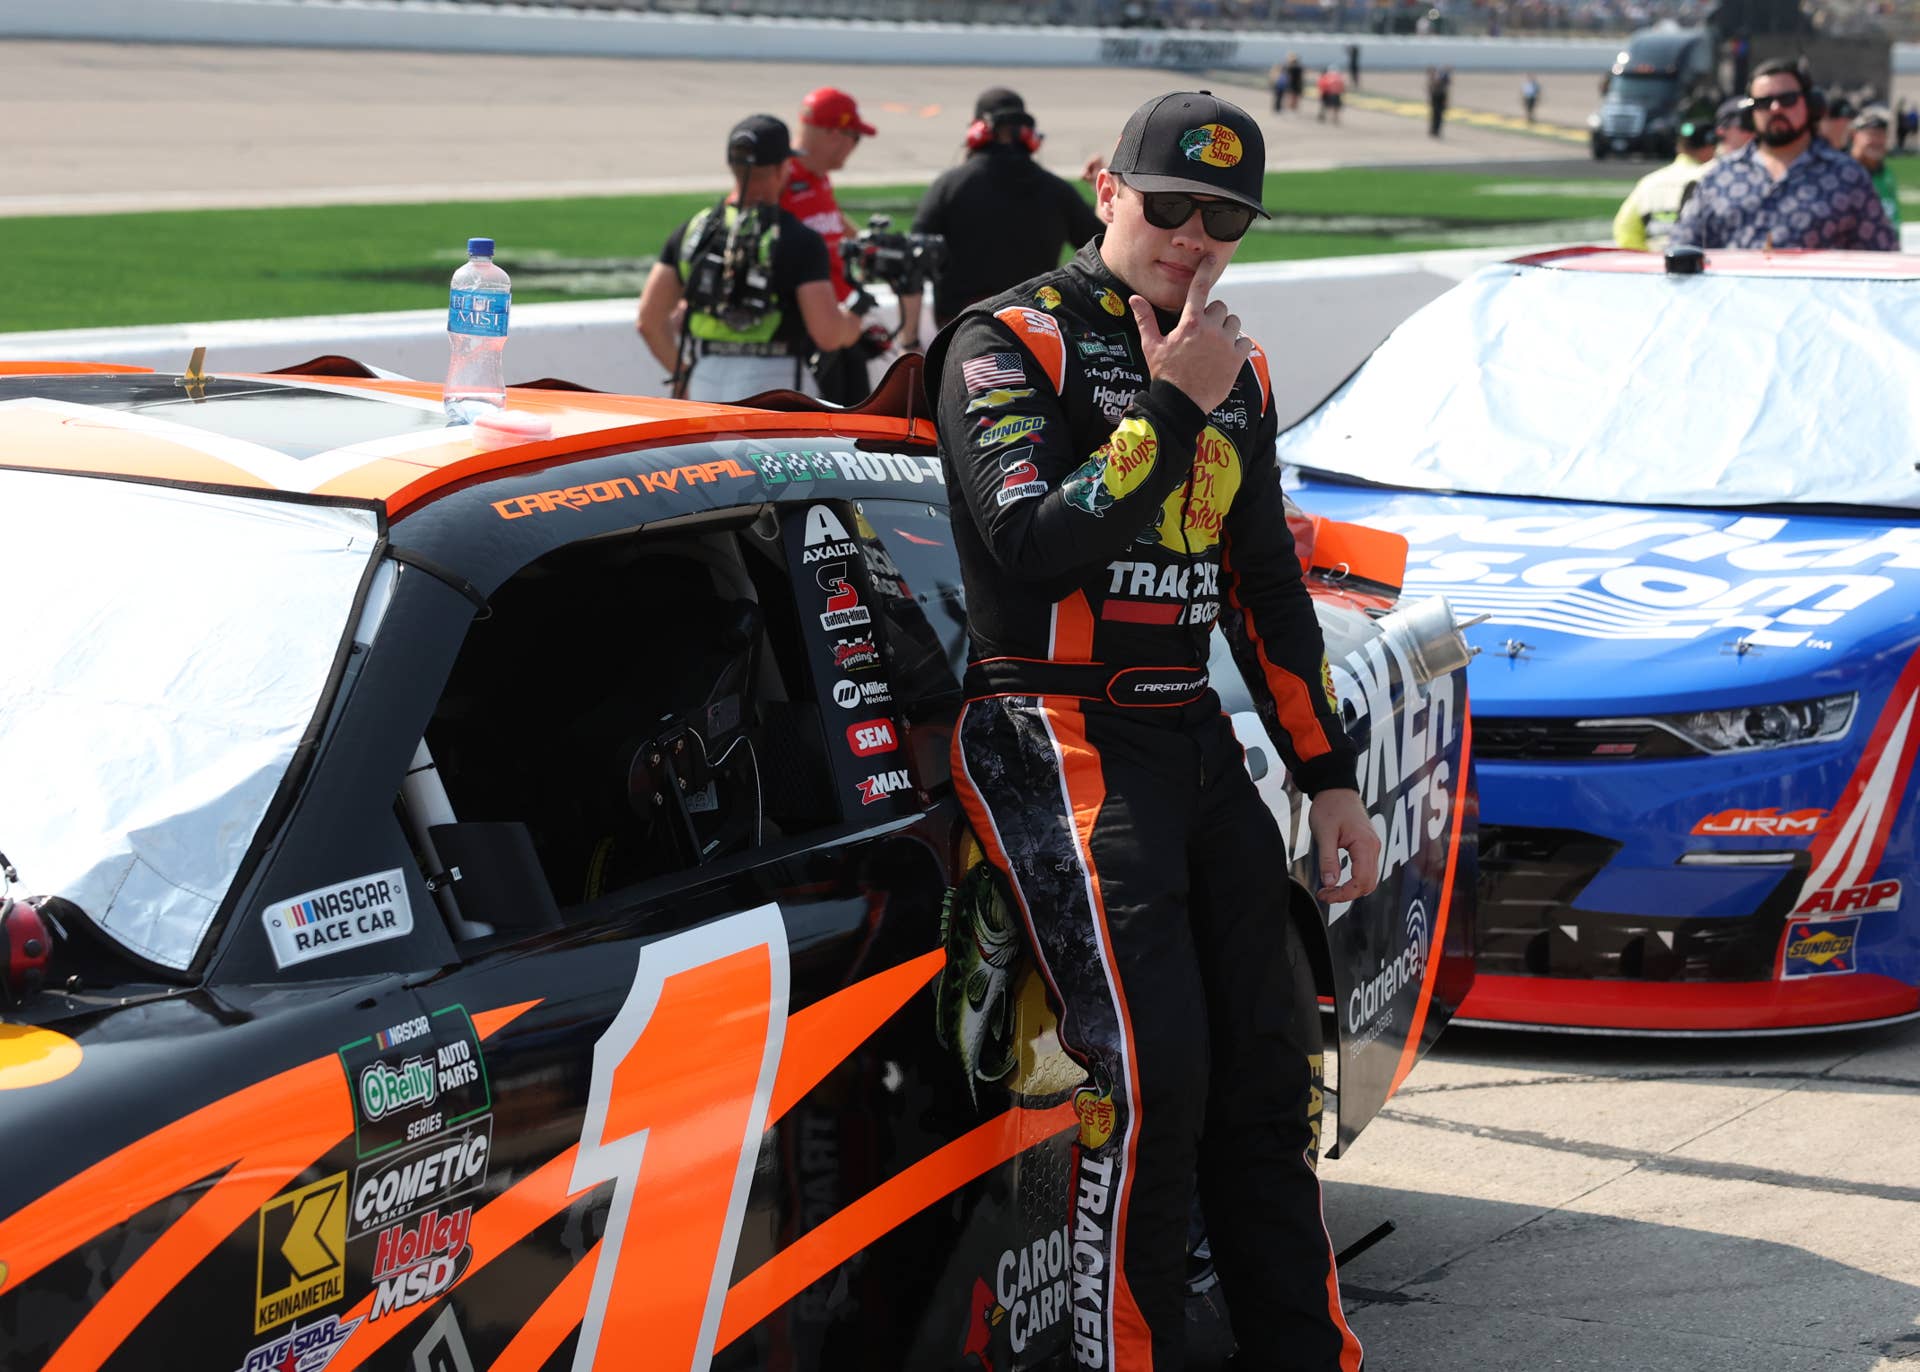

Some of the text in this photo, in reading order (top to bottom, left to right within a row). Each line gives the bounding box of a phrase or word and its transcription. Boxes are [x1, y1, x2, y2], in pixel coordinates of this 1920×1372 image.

[1211, 138, 1231, 151] Pro
[1213, 125, 1237, 142] Bass
[1209, 146, 1239, 165] Shops
[457, 310, 500, 326] MIST
[980, 416, 1045, 446] SUNOCO
[489, 459, 756, 520] CARSON KVAPIL
[802, 542, 859, 564] AXALTA
[860, 681, 888, 697] Miller
[863, 693, 892, 706] Welders
[1134, 682, 1189, 693] CARSON
[855, 725, 893, 750] SEM
[1702, 816, 1819, 836] JRM
[311, 880, 393, 921] NASCAR
[1794, 881, 1899, 915] ARP
[295, 909, 398, 952] RACE CAR
[1791, 938, 1850, 957] SUNOCO
[1349, 940, 1419, 1034] Clarience
[388, 1015, 431, 1046] NASCAR
[437, 1040, 471, 1070] AUTO
[364, 1064, 434, 1113] O'Reilly
[438, 1060, 478, 1093] PARTS
[407, 1112, 442, 1141] SERIES
[354, 1134, 488, 1223] COMETIC
[362, 1201, 414, 1230] GASKET
[373, 1206, 473, 1280] Holley
[1073, 1156, 1115, 1370] TRACKER
[369, 1255, 457, 1321] MSD
[258, 1278, 341, 1329] KENNAMETAL
[294, 1321, 337, 1354] STAR
